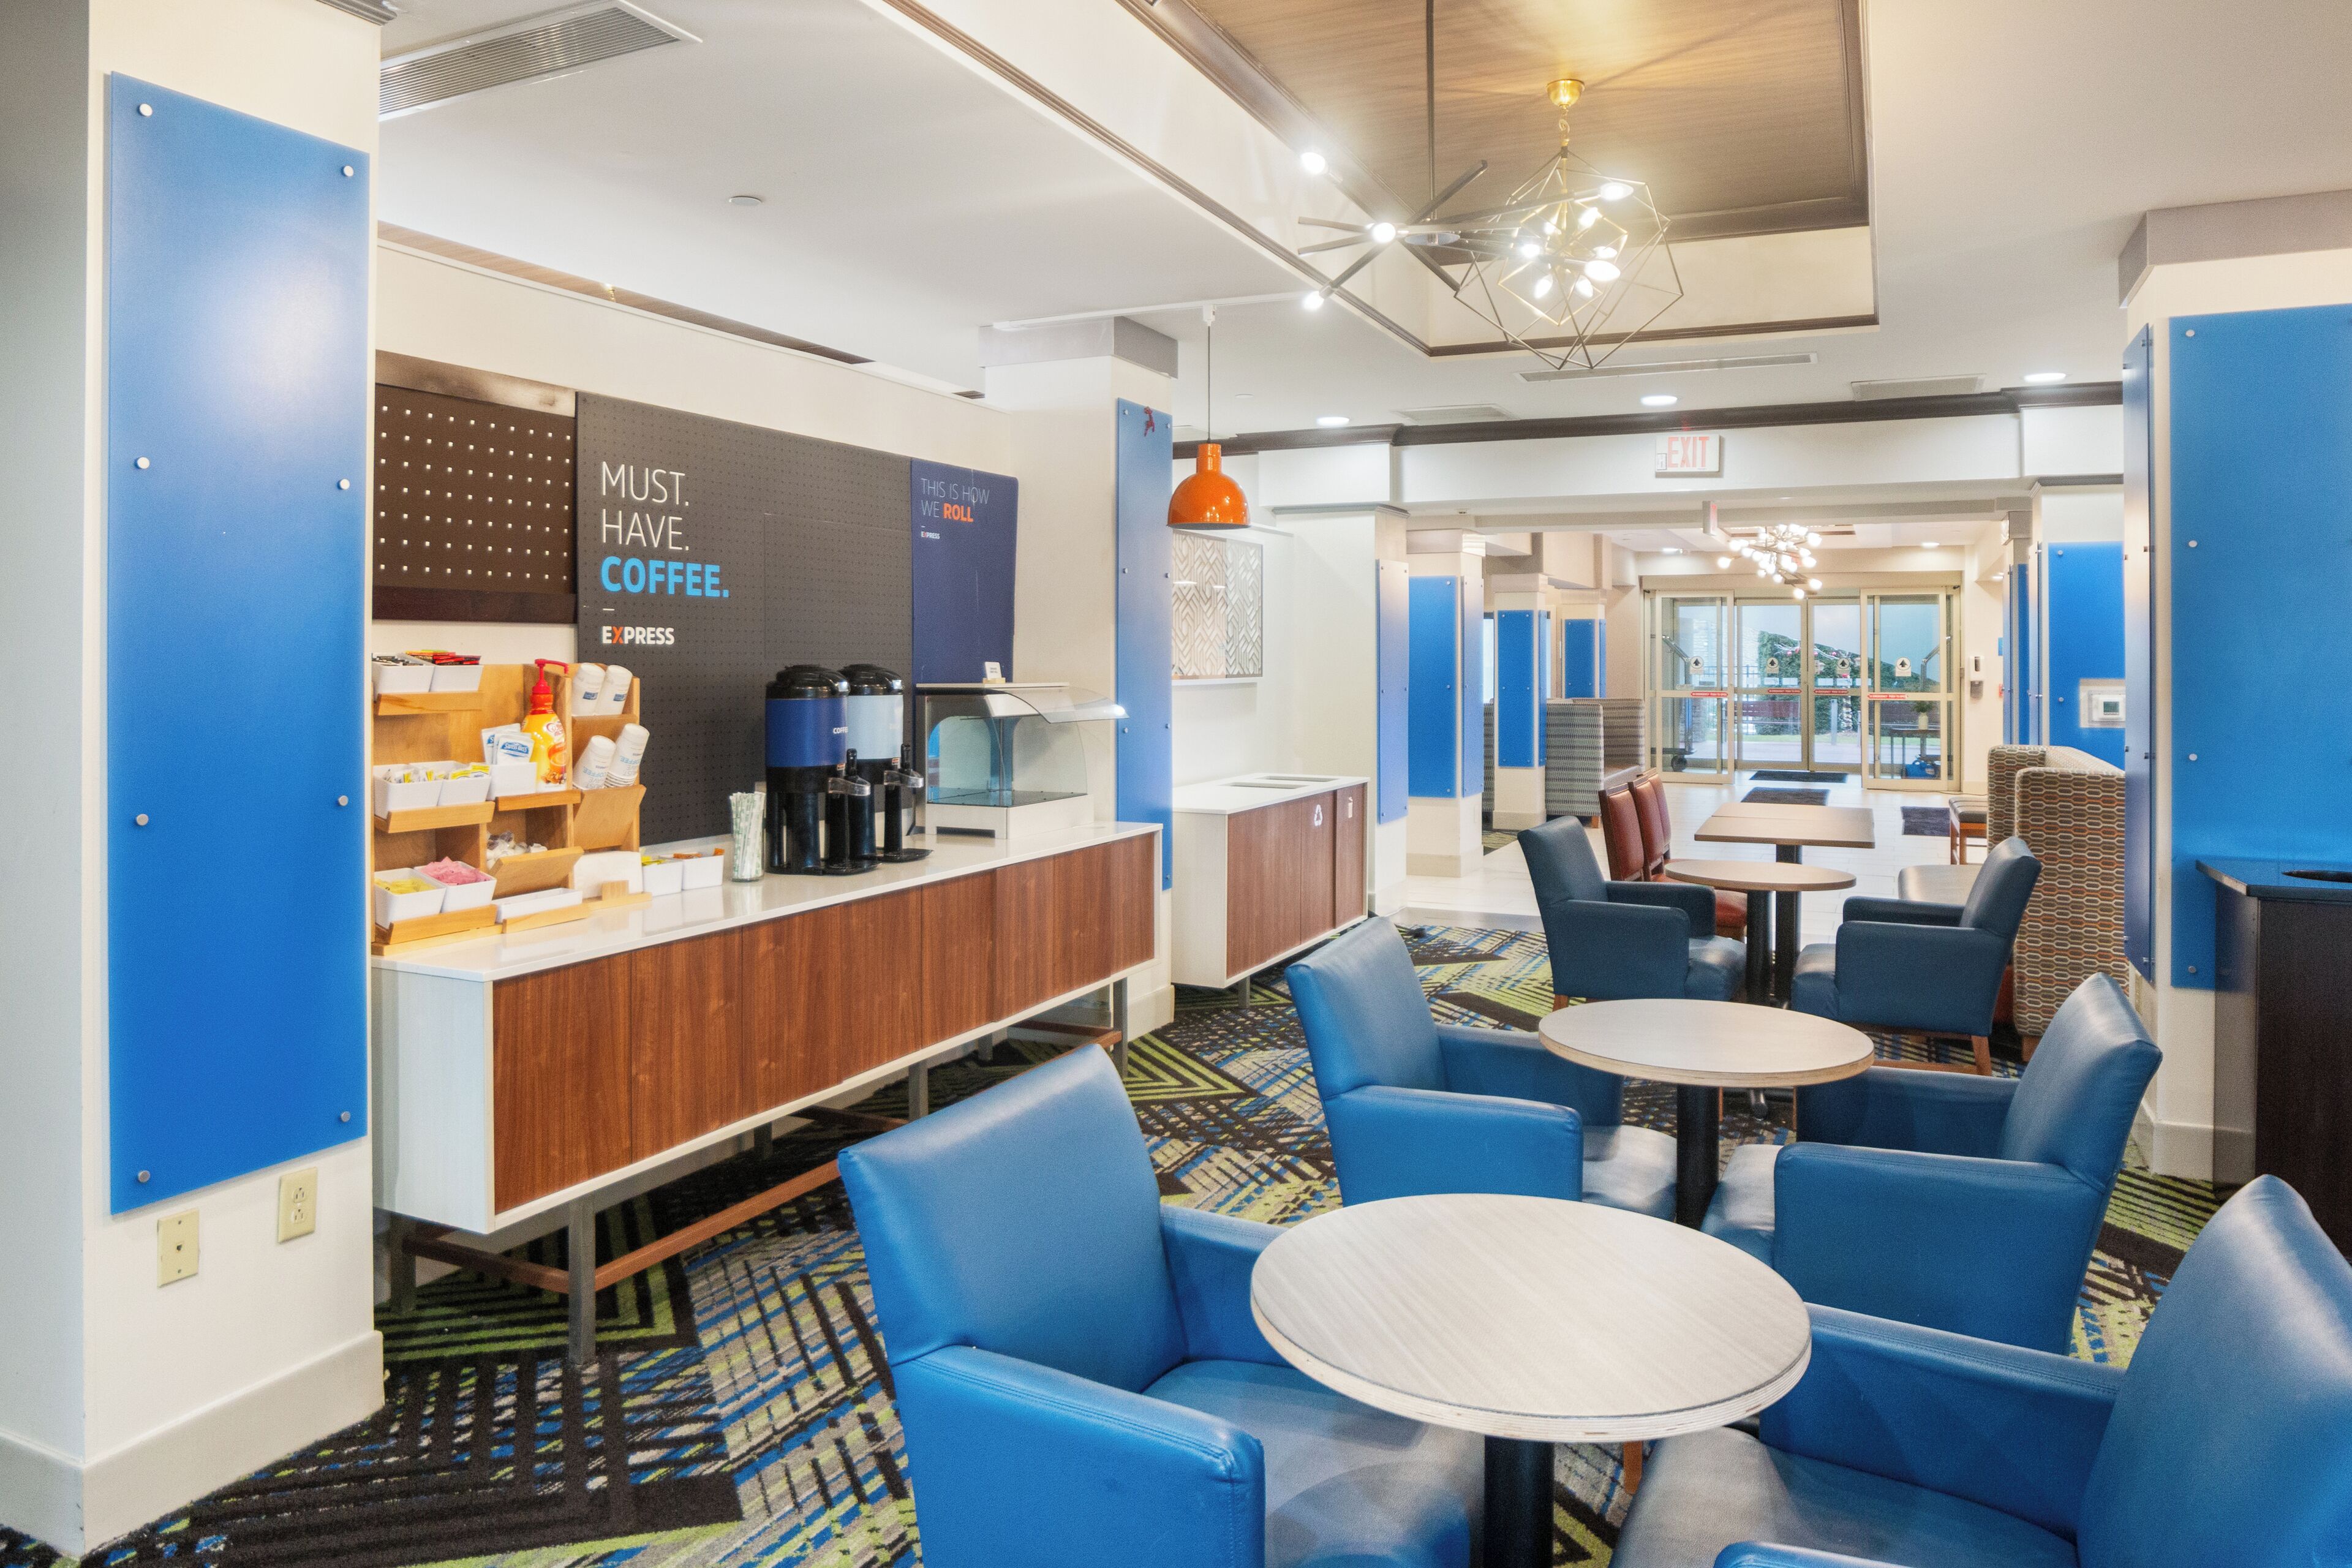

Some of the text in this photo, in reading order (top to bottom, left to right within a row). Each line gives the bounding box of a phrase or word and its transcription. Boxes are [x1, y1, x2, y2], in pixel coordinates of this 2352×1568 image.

[1668, 436, 1709, 467] EXIT
[602, 461, 688, 506] MUST.
[921, 478, 990, 505] THIS IS HOW
[921, 500, 974, 522] WE ROLL
[602, 508, 689, 551] HAVE.
[921, 531, 940, 540] EXPRESS
[600, 556, 729, 598] COFFEE.
[602, 626, 674, 645] EXPRESS
